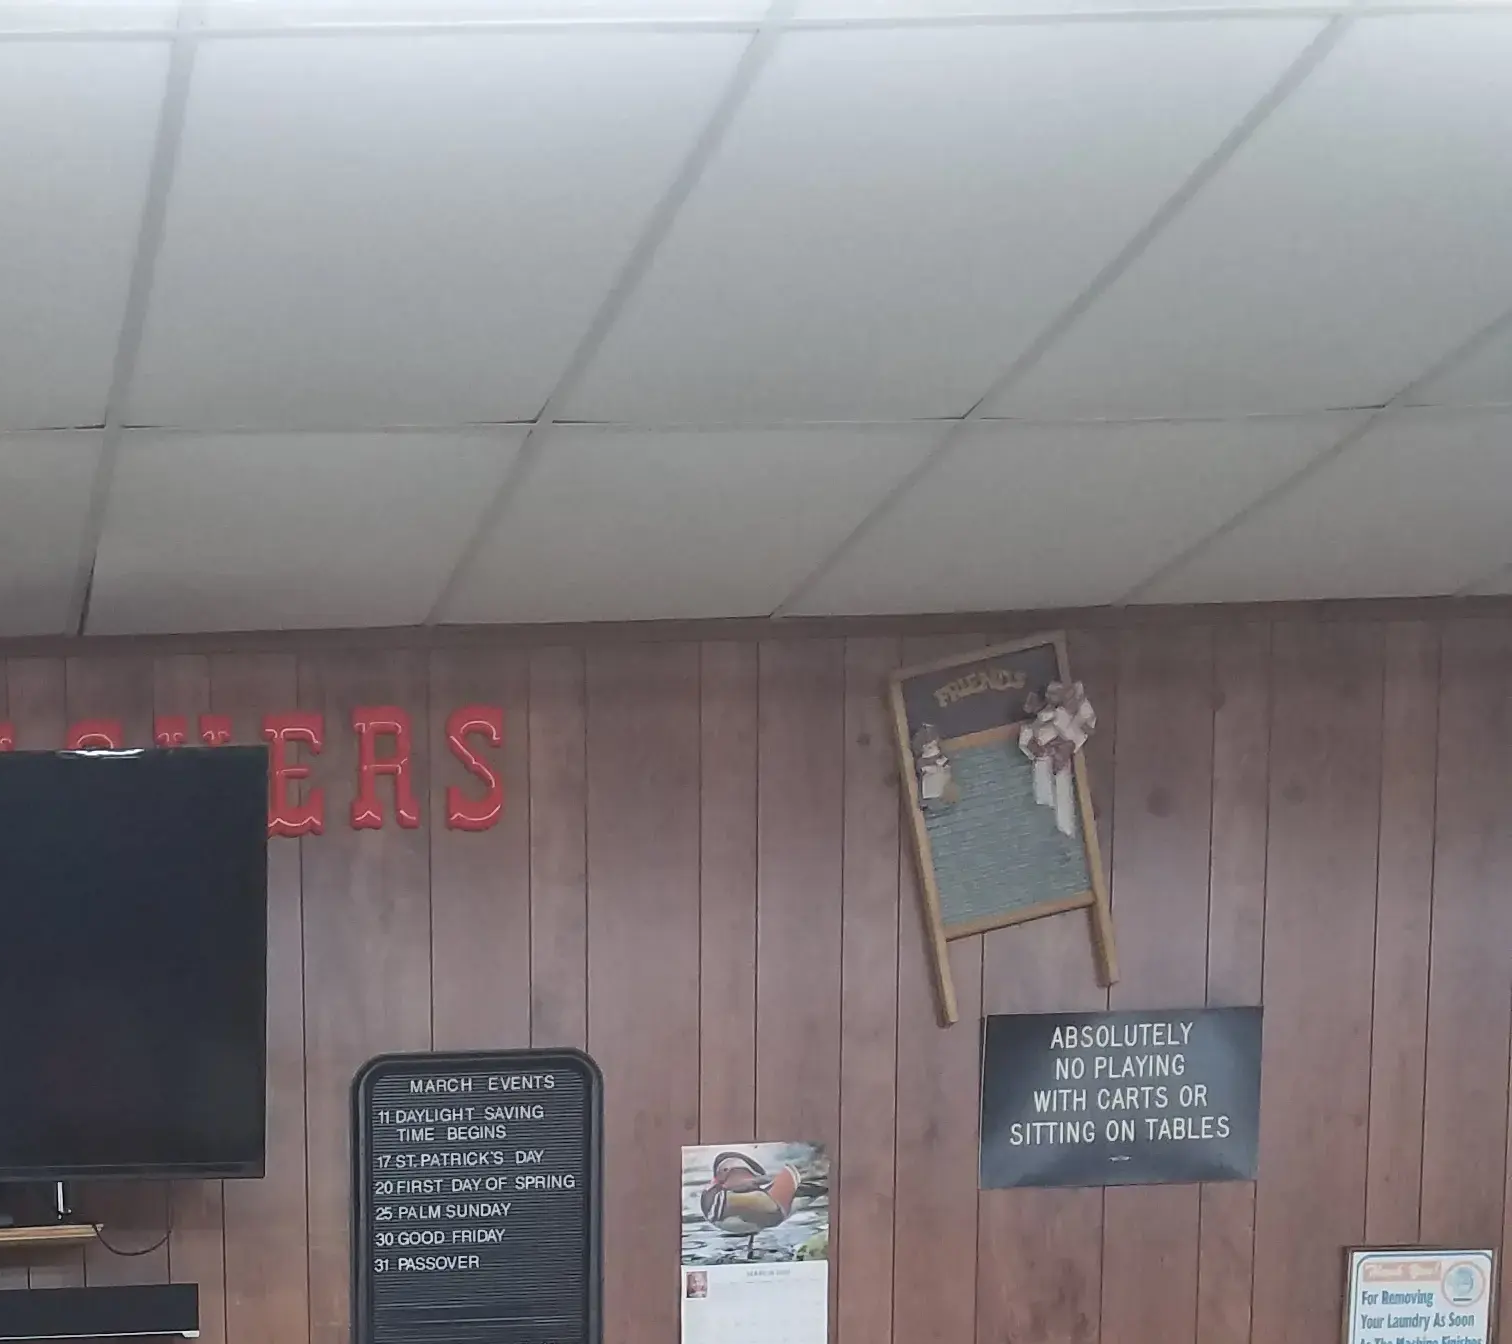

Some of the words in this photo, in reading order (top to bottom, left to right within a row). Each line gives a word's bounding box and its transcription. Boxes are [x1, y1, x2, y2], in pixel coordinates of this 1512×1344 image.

[1050, 1021, 1194, 1049] ABSOLUTELY
[1055, 1058, 1084, 1080] NO
[1094, 1054, 1185, 1079] PLAYING
[410, 1078, 472, 1093] MARCH
[488, 1075, 555, 1091] EVENTS
[1033, 1089, 1086, 1112] WITH
[1097, 1086, 1167, 1110] CARTS
[1180, 1084, 1208, 1107] OR
[378, 1111, 390, 1124] 11
[396, 1108, 474, 1123] DAYLIGHT
[484, 1105, 544, 1120] SAVING
[397, 1128, 434, 1142] TIME
[447, 1125, 506, 1140] BEGINS
[1010, 1121, 1095, 1146] SITTING
[1106, 1119, 1135, 1142] ON
[1145, 1116, 1230, 1140] TABLES
[377, 1156, 391, 1168] 17
[516, 1150, 544, 1164] DAY
[376, 1182, 393, 1194] 20
[397, 1179, 443, 1194] FIRST
[451, 1178, 481, 1192] DAY
[486, 1176, 507, 1191] OF
[515, 1174, 575, 1190] SPRING
[376, 1208, 392, 1220] 25
[398, 1205, 441, 1219] PALM
[446, 1203, 511, 1218] SUNDAY
[376, 1233, 393, 1246] 30
[398, 1231, 444, 1245] GOOD
[452, 1229, 505, 1243] FRIDAY
[374, 1259, 389, 1272] 31
[398, 1256, 480, 1271] PASSOVER
[1362, 1291, 1378, 1305] For
[1382, 1289, 1433, 1307] Removing
[1361, 1315, 1384, 1329] Your
[1388, 1313, 1430, 1331] Laundry
[1433, 1313, 1445, 1327] As
[1449, 1312, 1474, 1327] Soon
